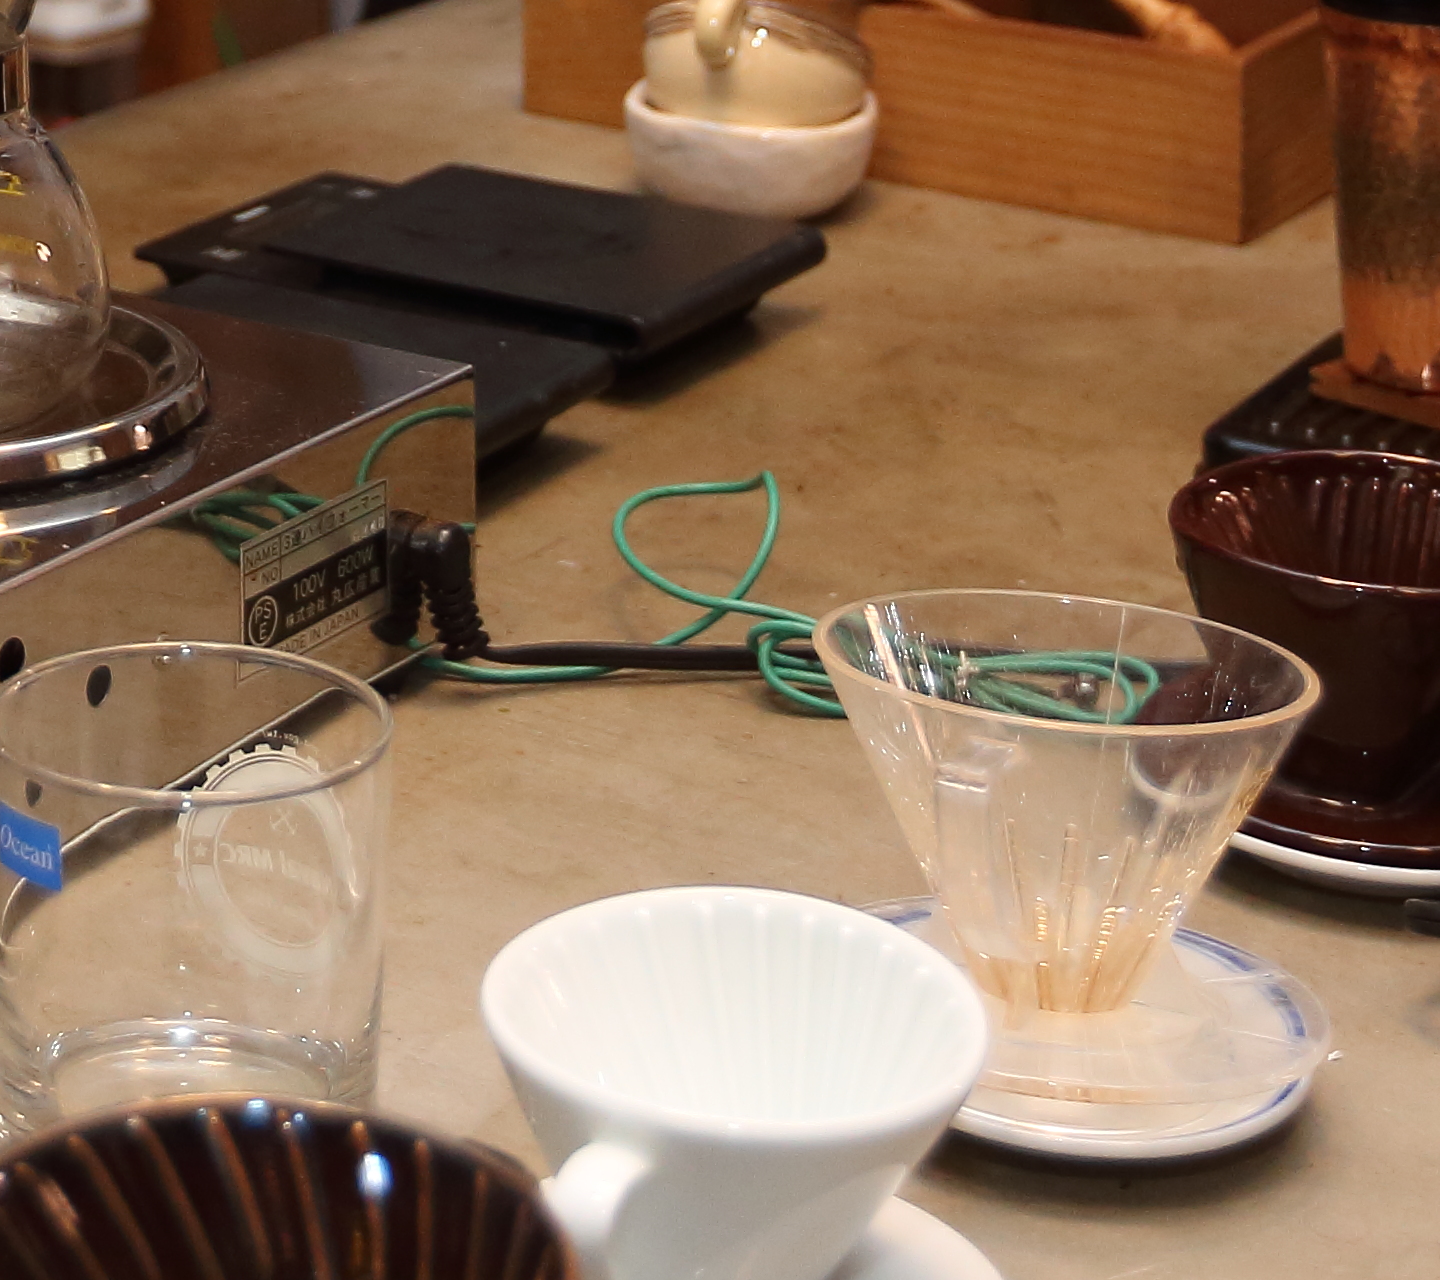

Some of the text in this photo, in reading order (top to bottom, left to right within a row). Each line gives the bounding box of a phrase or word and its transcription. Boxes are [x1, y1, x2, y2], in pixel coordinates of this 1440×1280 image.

[245, 540, 279, 567] NAME
[293, 544, 374, 601] 100V 600W
[308, 624, 321, 640] IN
[323, 609, 360, 636] JAPAN
[0, 824, 53, 870] Ocean
